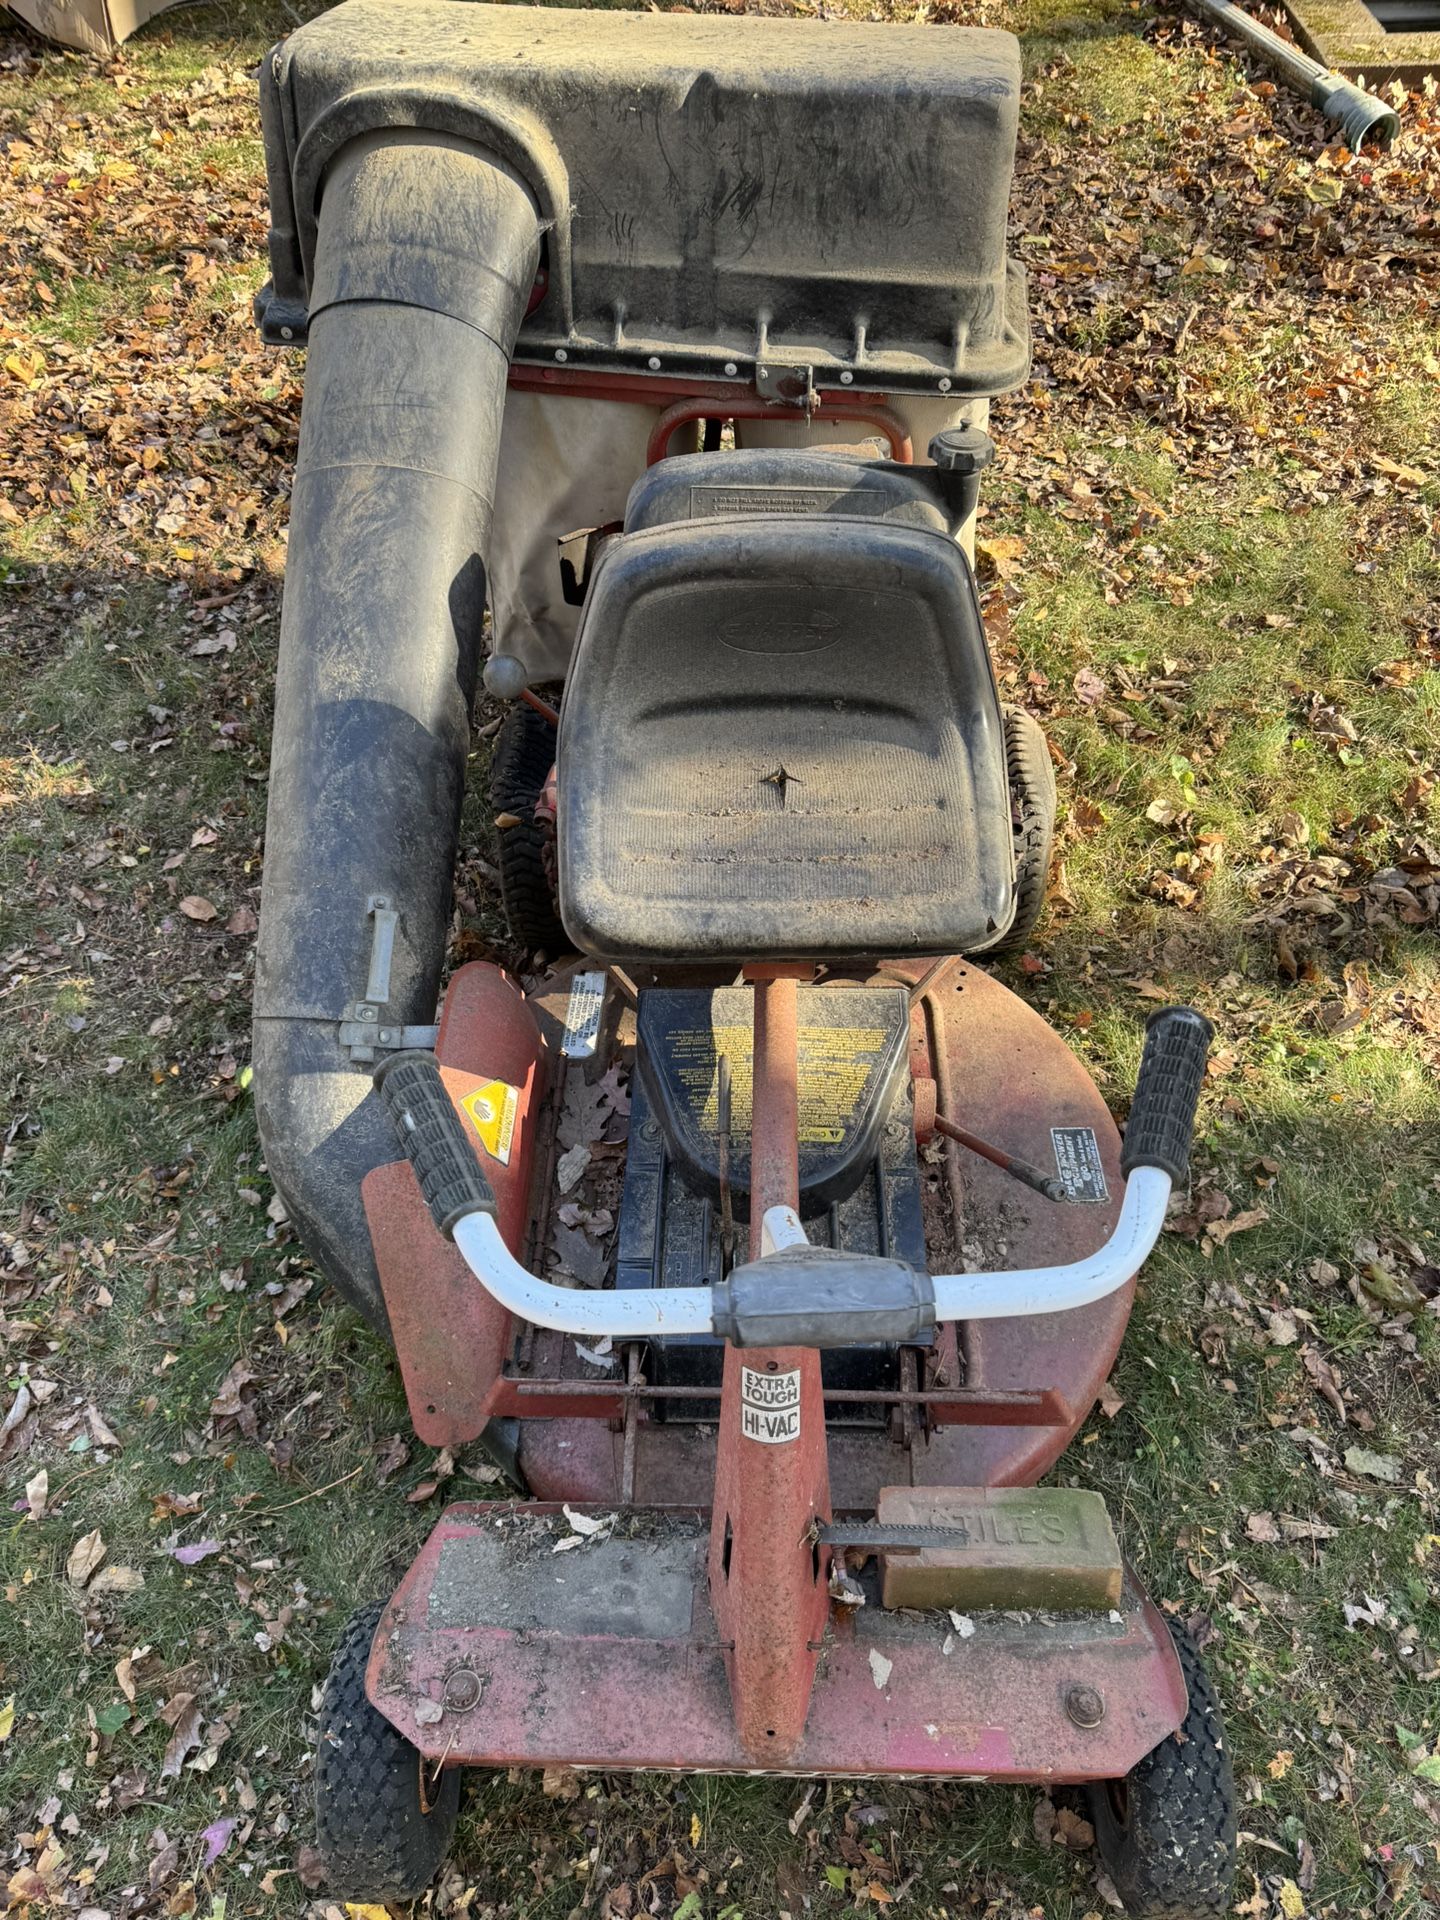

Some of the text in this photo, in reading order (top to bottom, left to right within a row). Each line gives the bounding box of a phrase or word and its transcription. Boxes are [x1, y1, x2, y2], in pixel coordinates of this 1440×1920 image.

[591, 1001, 600, 1026] CAUTION
[1055, 1133, 1070, 1168] POWER
[1064, 1134, 1084, 1189] EQUIPMENT
[744, 1384, 797, 1404] TOUGH
[746, 1372, 796, 1391] EXTRA
[744, 1410, 798, 1438] HI-VAC
